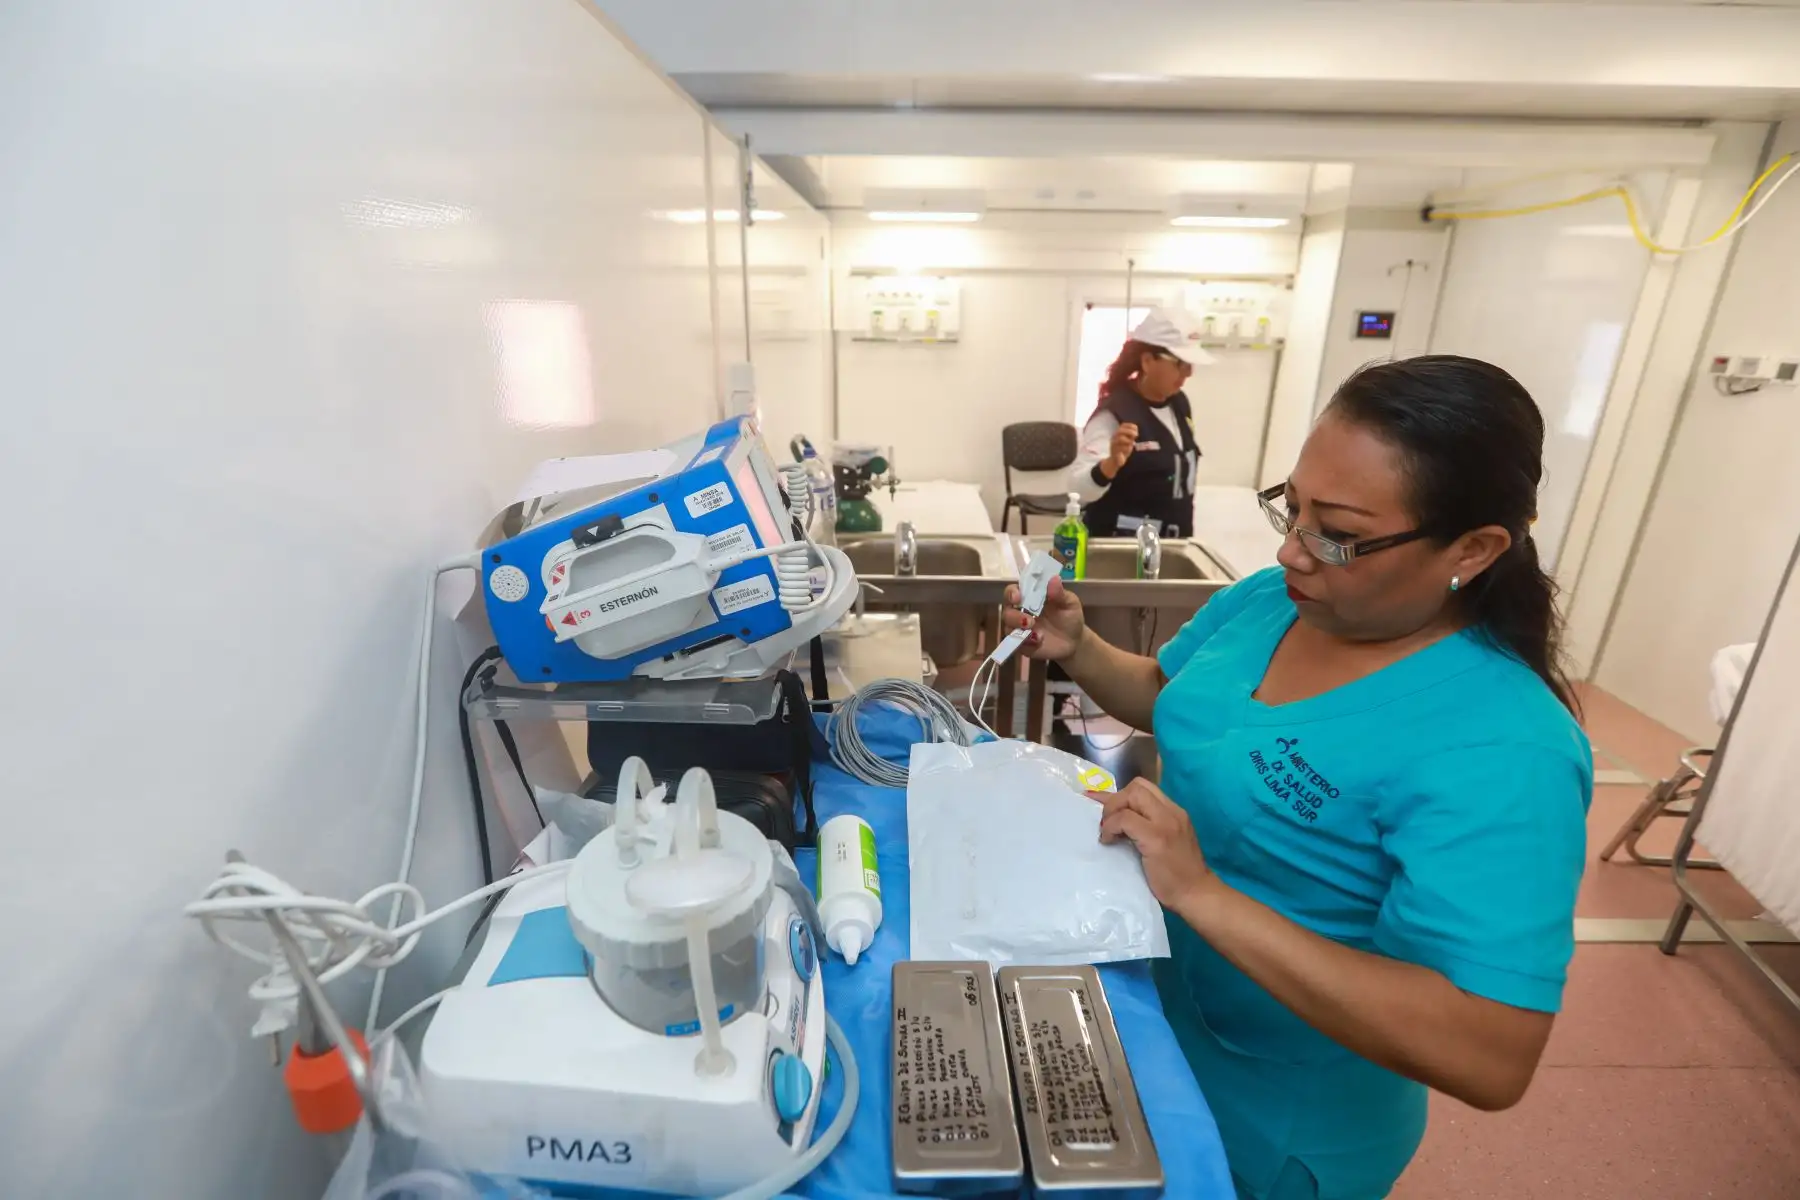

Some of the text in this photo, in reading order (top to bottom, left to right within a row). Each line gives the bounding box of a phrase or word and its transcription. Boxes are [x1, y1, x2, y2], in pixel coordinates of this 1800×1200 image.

[599, 586, 659, 613] ESTERNÓN
[580, 610, 591, 619] 3
[1249, 750, 1318, 823] DIRIS LIMA SUR
[1271, 759, 1323, 809] DE SALUD
[1288, 751, 1340, 799] MINISTERIO
[1004, 991, 1018, 1005] I
[1010, 1008, 1026, 1047] SUTURA
[1019, 1051, 1031, 1066] DE
[526, 1135, 632, 1164] PMA3
